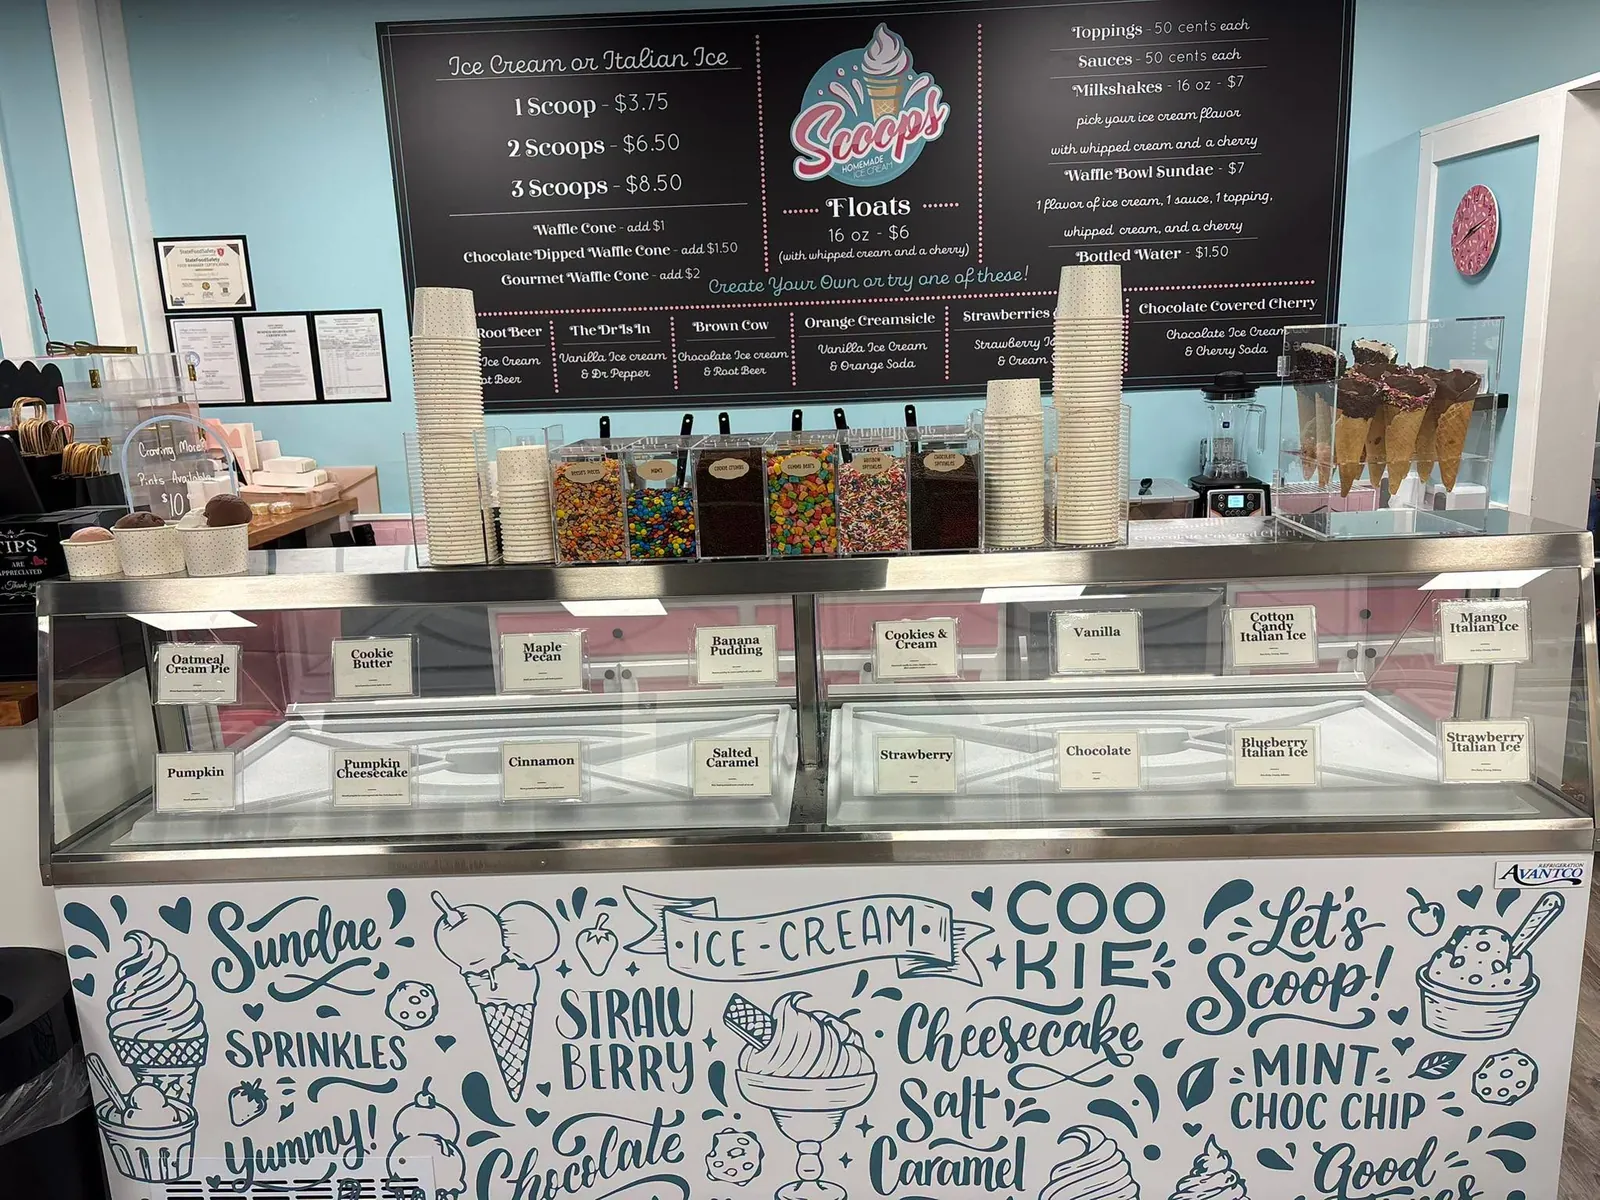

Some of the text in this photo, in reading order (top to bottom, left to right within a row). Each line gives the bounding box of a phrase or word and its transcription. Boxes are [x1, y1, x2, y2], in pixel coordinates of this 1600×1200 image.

[1072, 24, 1142, 41] Toppings
[1155, 22, 1172, 34] 50
[1178, 20, 1216, 33] cents
[1220, 19, 1250, 31] each
[449, 47, 728, 75] Ice Cream or Italian Ice
[1072, 81, 1162, 96] Milkshakes
[1178, 79, 1190, 91] 16
[1196, 81, 1210, 90] oz
[1228, 75, 1243, 88] $7
[516, 99, 522, 115] 1
[528, 98, 596, 118] Scoop
[615, 93, 667, 113] $3.75
[792, 86, 949, 179] Scoops
[508, 140, 520, 157] 2
[526, 139, 604, 159] Scoops
[624, 134, 679, 154] $6.50
[841, 155, 883, 173] HOMEMADE
[853, 161, 893, 178] ICE CREAM
[1064, 168, 1113, 181] Waffle
[1114, 166, 1152, 179] Bowl
[1156, 164, 1213, 178] Sundae
[1228, 162, 1244, 175] $7
[512, 180, 523, 197] 3
[529, 180, 607, 199] Scoops
[626, 174, 681, 194] $8.50
[826, 197, 910, 217] Floats
[533, 223, 578, 235] Waffle
[581, 223, 616, 233] Cone
[627, 221, 651, 232] add
[653, 220, 664, 231] $1
[829, 228, 844, 242] 16
[851, 231, 869, 241] oz
[889, 225, 909, 240] $6
[464, 250, 532, 262] Chocolate
[534, 247, 585, 262] Dipped
[587, 246, 632, 257] Waffle
[635, 245, 670, 256] Cone
[681, 244, 705, 254] add
[707, 242, 737, 254] $1.50
[779, 250, 807, 264] (with
[809, 248, 854, 262] whipped
[857, 250, 892, 258] cream
[894, 245, 917, 256] and
[929, 243, 969, 257] cherry)
[1076, 249, 1130, 262] Bottled
[1134, 249, 1181, 260] Water
[1196, 246, 1228, 259] $1.50
[709, 265, 1028, 296] Create Your Own or try one of these!
[1139, 298, 1316, 314] Chocolate Covered Cherry
[692, 320, 767, 332] Brown Cow
[805, 313, 935, 329] Orange Creamsicle
[570, 324, 650, 336] The Dr Is In
[139, 442, 176, 461] Craving
[138, 470, 211, 486] Pints Available
[1250, 611, 1293, 623] Cotton
[1461, 612, 1507, 626] Mango
[885, 629, 947, 640] Cookies &
[1074, 627, 1120, 638] Vanilla
[1253, 621, 1293, 633] Candy
[1450, 621, 1519, 633] Italian Ice
[713, 636, 759, 646] Banana
[896, 639, 937, 649] Cream
[1240, 630, 1306, 642] Italian Ice
[351, 648, 393, 659] Cookie
[523, 642, 562, 654] Maple
[710, 644, 763, 657] Pudding
[172, 654, 224, 665] Oatmeal
[353, 658, 392, 669] Butter
[524, 652, 561, 662] Pecan
[166, 664, 230, 674] Cream Pie
[1241, 737, 1308, 750] Blueberry
[1446, 731, 1524, 745] Strawberry
[713, 748, 752, 758] Salted
[1066, 746, 1131, 757] Chocolate
[1241, 746, 1308, 757] Italian Ice
[1451, 741, 1521, 752] Italian Ice
[509, 756, 574, 767] Cinnamon
[706, 757, 759, 768] Caramel
[880, 749, 953, 761] Strawberry
[168, 767, 224, 779] Pumpkin
[344, 759, 400, 771] Pumpkin
[337, 768, 407, 779] Cheesecake
[1499, 864, 1582, 885] AVANTCO
[1007, 881, 1165, 935] COO
[1248, 885, 1386, 963] Let's
[208, 900, 382, 994] Sundae
[1016, 939, 1152, 989] KIE
[1186, 944, 1395, 1036] Scoop!
[556, 986, 693, 1043] STRAW
[897, 993, 1143, 1072] Cheesecake
[225, 1030, 407, 1070] SPRINKLES
[562, 1042, 694, 1094] BERRY
[1253, 1043, 1379, 1087] MINT
[897, 1076, 1000, 1143] Salt
[1231, 1092, 1425, 1130] CHOC CHIP
[224, 1104, 376, 1193] Yummy!
[475, 1106, 686, 1200] Chocolate
[870, 1135, 1026, 1196] Caramel
[1313, 1136, 1438, 1200] Good
